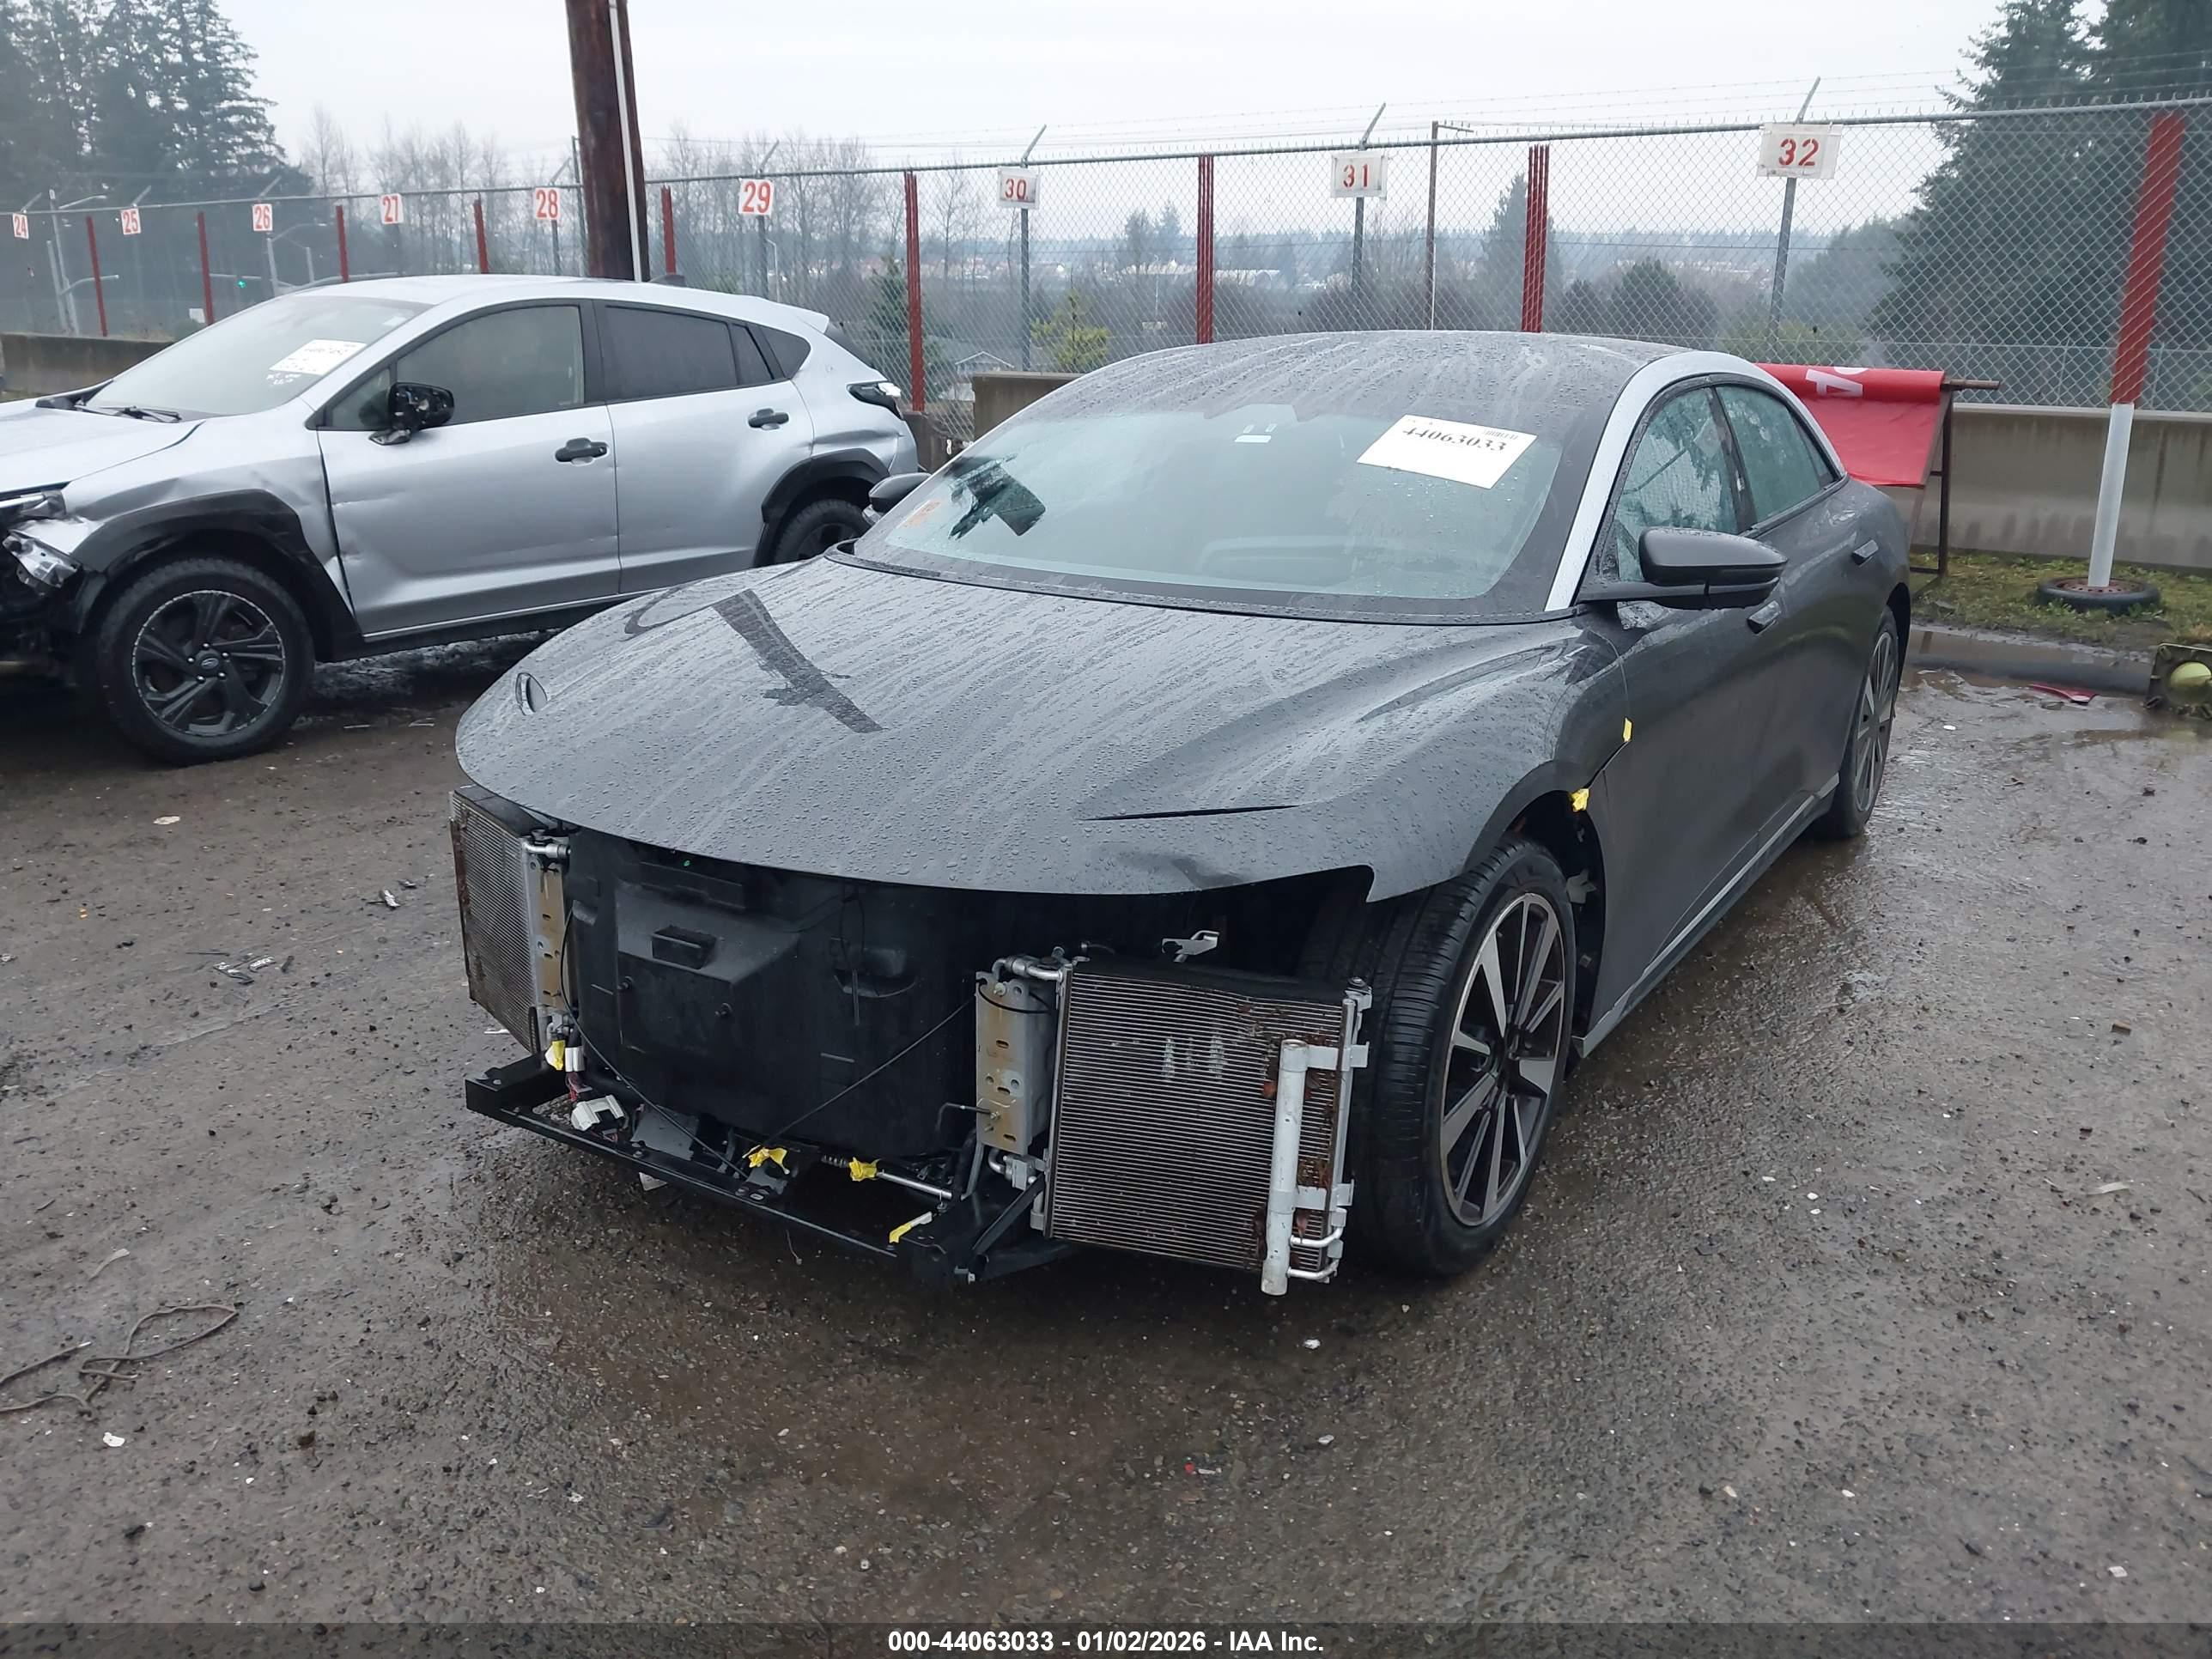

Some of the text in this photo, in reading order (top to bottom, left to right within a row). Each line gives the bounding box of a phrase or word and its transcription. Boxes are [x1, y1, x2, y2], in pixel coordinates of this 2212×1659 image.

[1778, 137, 1820, 167] 32
[1005, 178, 1028, 200] 30
[1342, 163, 1370, 189] 31
[382, 195, 399, 222] 27
[535, 189, 559, 219] 28
[742, 179, 772, 214] 29
[13, 216, 27, 236] 24
[123, 207, 139, 230] 25
[254, 204, 270, 230] 26
[1402, 427, 1507, 452] 44063033
